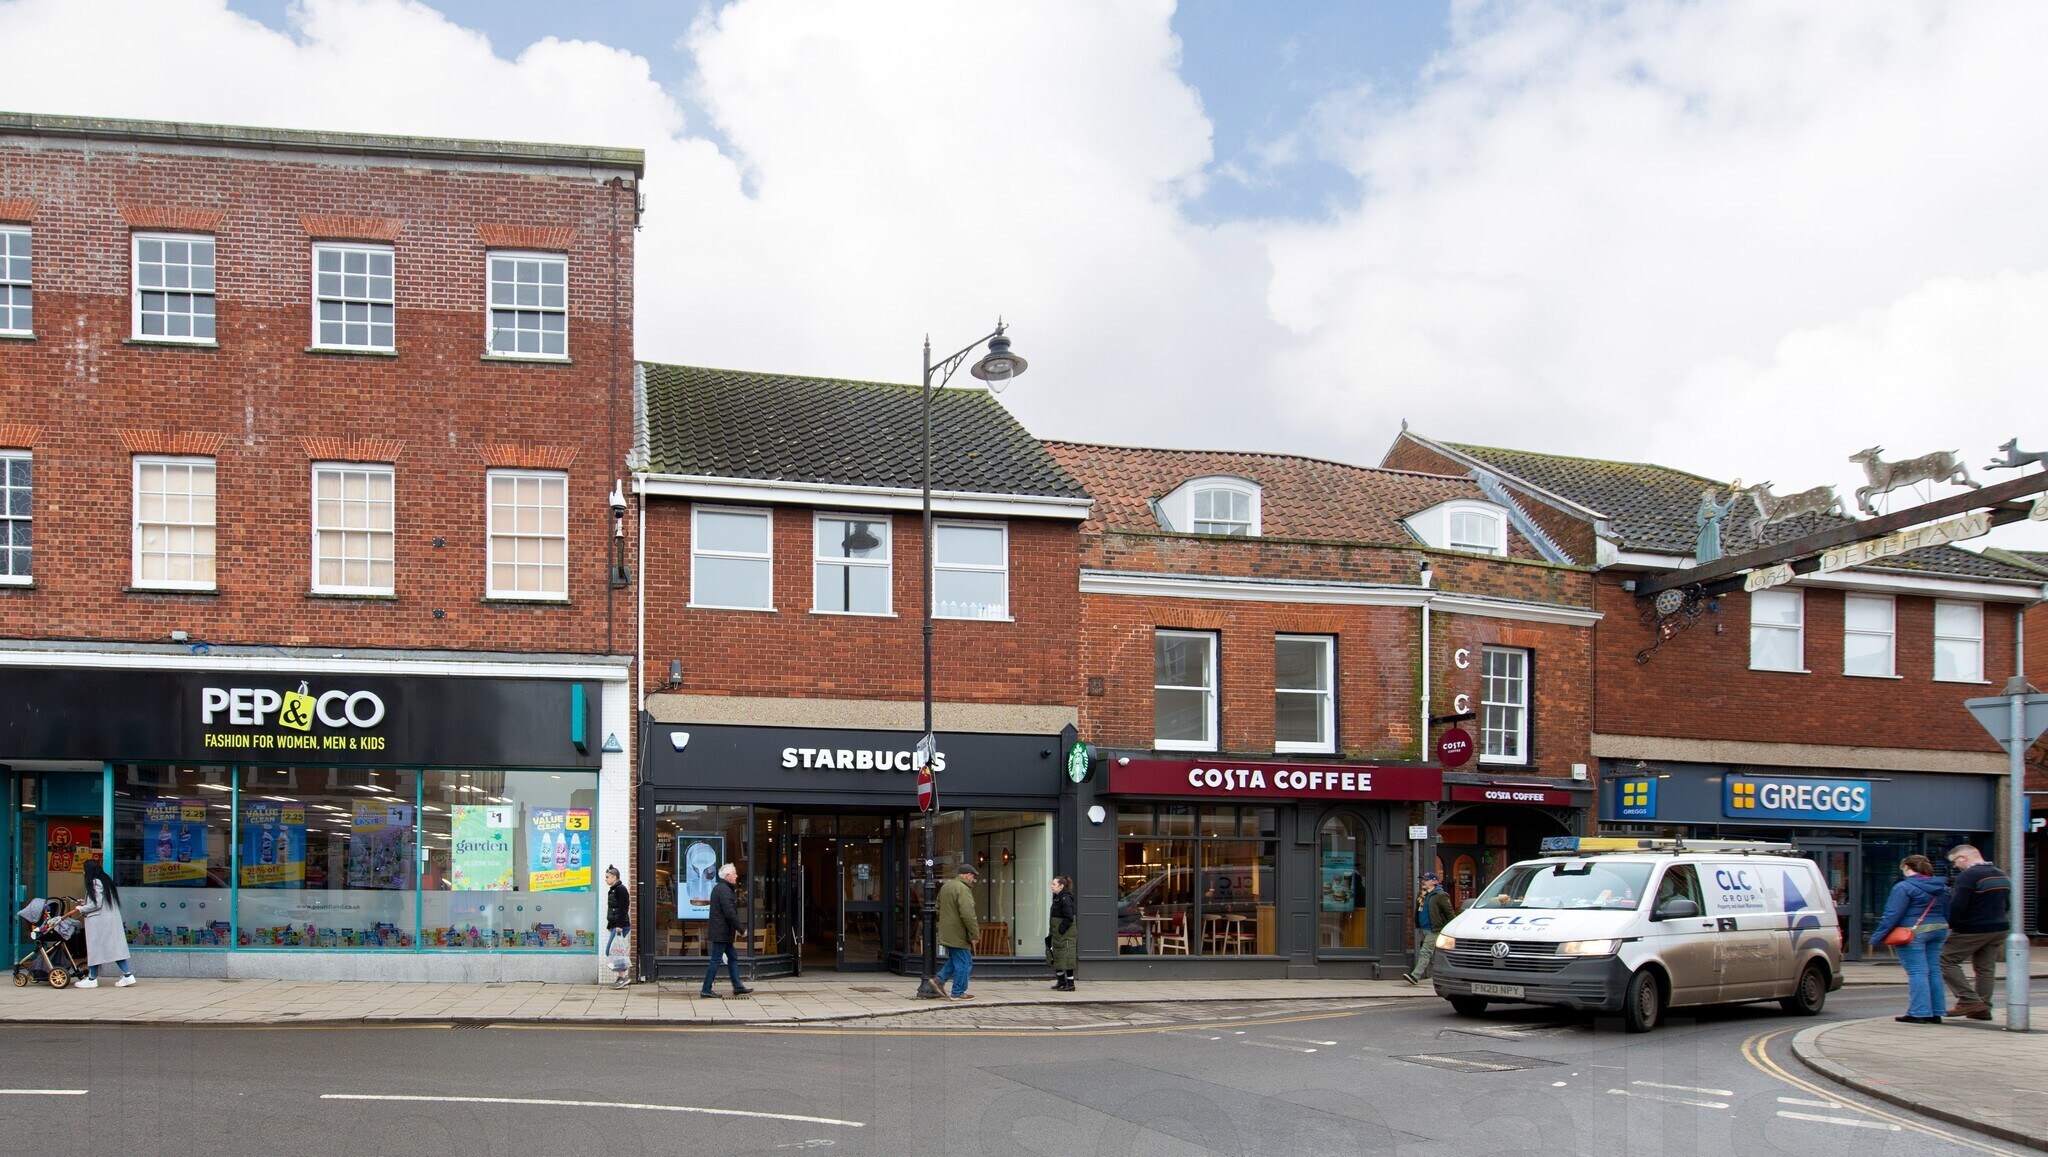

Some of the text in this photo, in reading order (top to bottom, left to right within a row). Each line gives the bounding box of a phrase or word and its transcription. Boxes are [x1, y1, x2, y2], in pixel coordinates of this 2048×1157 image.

[1822, 519, 1983, 570] DEREHAM
[1750, 566, 1788, 589] 1954
[204, 734, 385, 750] FASHION FOR WOMEN, MEN & KIDS
[1443, 741, 1466, 750] COSTA
[1188, 768, 1372, 791] COSTA COFFEE
[1485, 791, 1545, 801] COSTA COFFEE
[1760, 783, 1867, 813] GREGGS
[146, 806, 178, 815] VALUE
[246, 809, 279, 818] VALUE
[492, 813, 502, 823] £1
[532, 815, 564, 825] VALUE
[456, 840, 508, 854] garden
[148, 865, 166, 873] 25%
[535, 873, 553, 881] 25%
[1716, 870, 1752, 890] CLC
[1486, 916, 1556, 926] CLC
[1474, 984, 1519, 995] FN20 NPY
